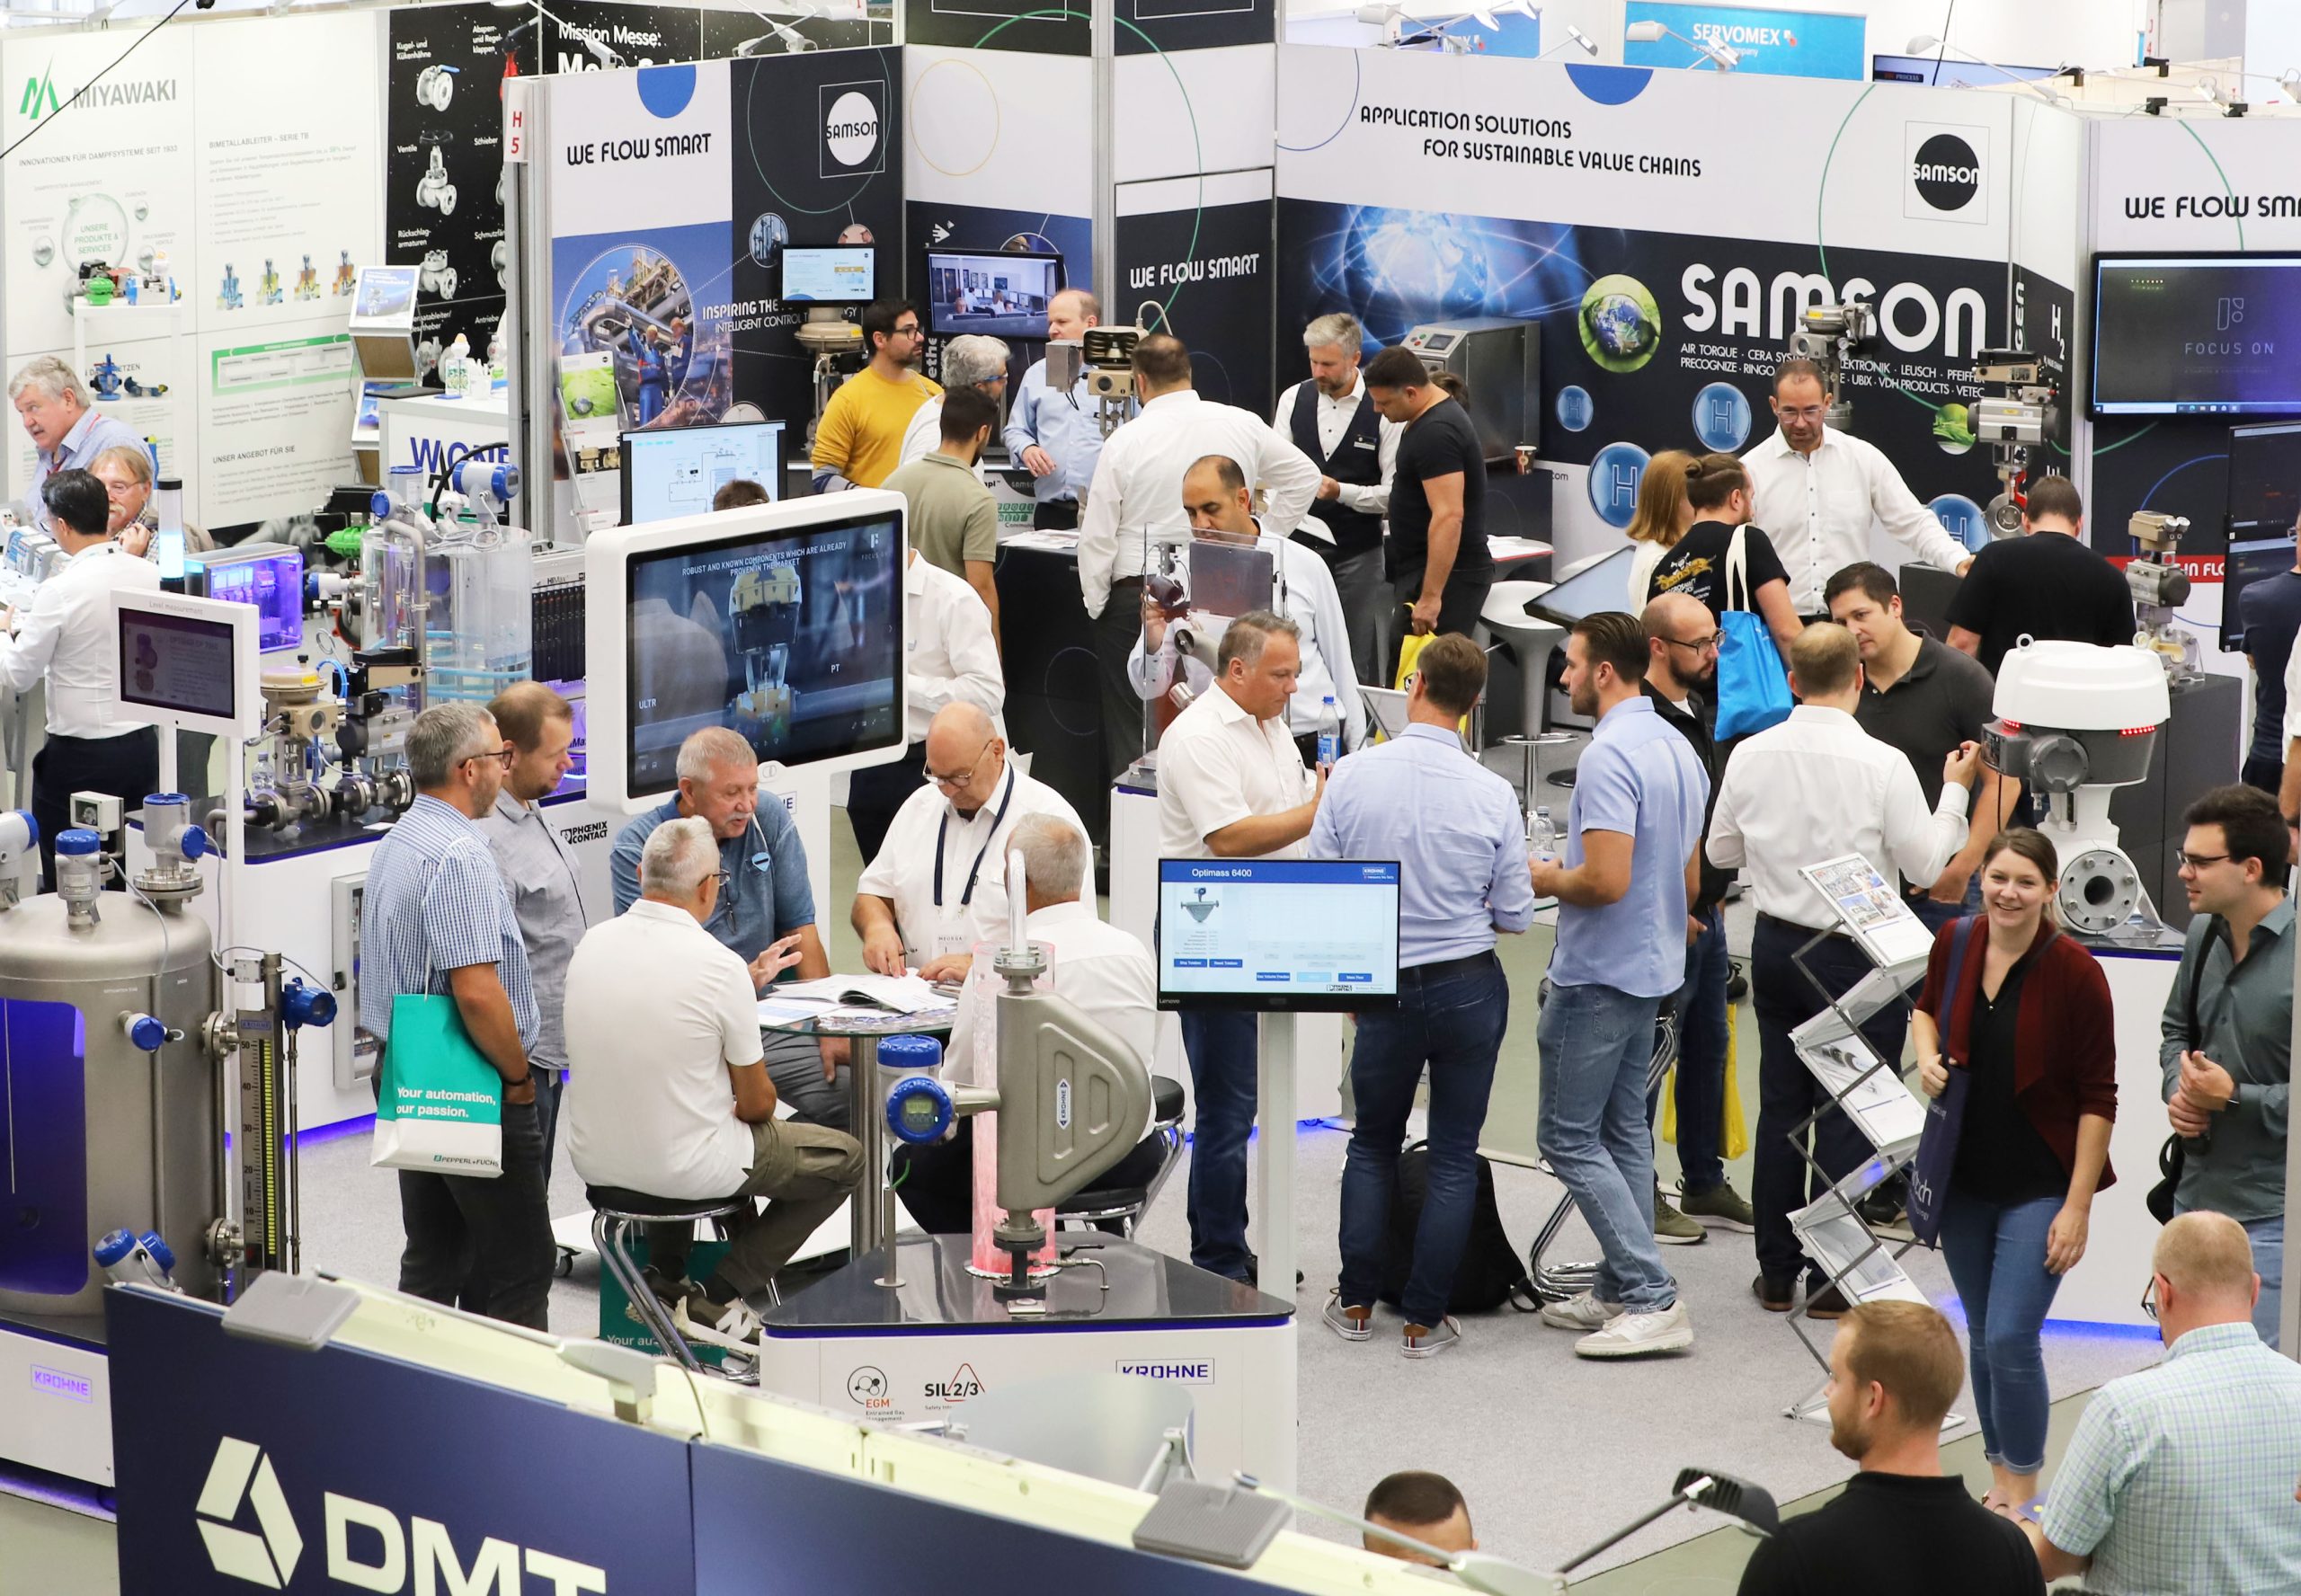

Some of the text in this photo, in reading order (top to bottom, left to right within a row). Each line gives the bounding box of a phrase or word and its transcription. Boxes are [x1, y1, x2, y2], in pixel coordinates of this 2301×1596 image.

[472, 35, 484, 43] und
[558, 22, 662, 47] Mission Messe:
[1692, 22, 1781, 46] SERVOMEX
[416, 40, 428, 48] und
[473, 45, 495, 55] klappen
[73, 79, 177, 110] MIYAWAKI
[513, 111, 522, 128] H
[1361, 105, 1572, 139] APPLICATION SOLUTIONS
[826, 120, 879, 140] SAMSON
[397, 144, 418, 154] Ventile
[474, 137, 498, 146] Schieber
[511, 137, 520, 154] 5
[567, 132, 712, 165] WE FLOW SMART
[19, 155, 71, 167] INNOVATIONEN
[89, 147, 144, 160] DAMPFSYSTEME
[147, 146, 161, 155] SEIT
[1424, 138, 1701, 178] FOR SUSTAINABLE VALUE CHAINS
[1912, 162, 1980, 185] SAMSON
[2125, 195, 2301, 219] WE FLOW SM
[80, 223, 109, 233] UNSERE
[398, 227, 431, 238] Rückschlag-
[75, 234, 112, 244] PRODUKTE
[398, 240, 427, 248] armaturen
[78, 244, 111, 254] SERVICES
[1130, 253, 1260, 289] WE FLOW SMART
[703, 301, 757, 321] INSPIRING
[759, 298, 778, 313] THE
[1680, 263, 1986, 359] SAMSON
[475, 315, 500, 324] Antriebe
[715, 317, 762, 333] INTELLIGENT
[763, 314, 803, 329] CONTROL
[2185, 341, 2274, 355] FOCUS ON
[1680, 343, 1696, 355] AIR
[1699, 344, 1737, 359] TORQUE
[1747, 349, 1772, 362] CERA
[1840, 359, 1890, 374] LEKTRONIK
[1901, 364, 1936, 378] LEUSCH
[1680, 357, 1737, 373] PRECOGNIZE
[1743, 363, 1776, 377] RINGO
[1852, 374, 1872, 386] UBIX
[1879, 377, 1899, 389] VDH
[1900, 379, 1950, 395] PRODUCTS
[1956, 385, 1986, 399] VETEC
[213, 454, 235, 464] UNSER
[236, 449, 268, 460] ANGEBOT
[270, 447, 283, 455] FÜR
[682, 541, 847, 576] ROBUST AND KNOWN COMPONENTS WHICH ARE ALREADY
[730, 565, 754, 577] PROVEN
[763, 562, 775, 572] THE
[776, 557, 800, 570] MARKET
[831, 664, 840, 674] PT
[639, 697, 657, 709] ULTR
[572, 829, 609, 844] CONTACT
[1192, 868, 1230, 879] Optimass
[1232, 868, 1252, 877] 6400
[241, 1041, 250, 1049] 50
[242, 1083, 251, 1091] 40
[397, 1086, 496, 1105] Your automation,
[396, 1104, 469, 1119] our passion.
[607, 1334, 635, 1345] Your
[1123, 1364, 1209, 1379] KROHNE
[34, 1370, 89, 1396] KROHNE
[925, 1382, 979, 1397] SIL 2/3
[866, 1398, 890, 1408] EGM
[324, 1491, 606, 1596] DMT
